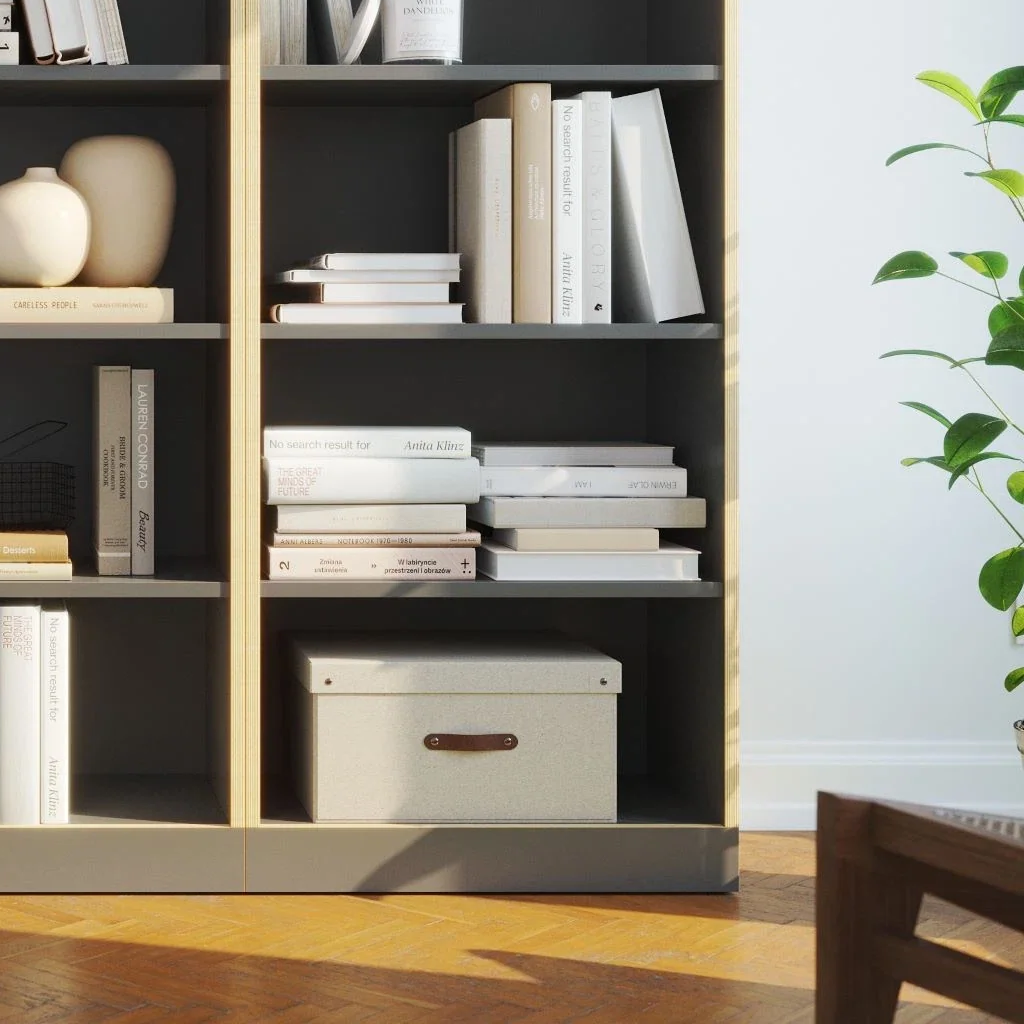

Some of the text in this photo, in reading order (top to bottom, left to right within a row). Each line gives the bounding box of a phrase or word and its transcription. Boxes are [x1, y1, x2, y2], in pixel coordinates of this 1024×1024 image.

[563, 105, 573, 216] No search result for
[562, 252, 573, 317] Anita Klinz
[13, 300, 78, 310] CARELESS PEOPLE
[118, 436, 126, 460] BRIDE
[269, 439, 371, 450] No search result for
[403, 440, 465, 451] Anita Klinz
[136, 383, 149, 552] LAUREN CONRAD Beauty
[278, 467, 323, 476] THE GREAT
[118, 470, 126, 500] GROOM
[278, 477, 317, 486] MINDS OF
[652, 481, 677, 490] ERWIN
[278, 487, 310, 496] FUTURE
[337, 537, 375, 545] NOTEBOOK
[3, 545, 36, 554] Desserts
[279, 561, 290, 570] 2
[405, 558, 437, 567] labiryncie
[384, 567, 421, 575] przestrzeni
[424, 566, 451, 574] obrazów
[3, 615, 12, 649] FUTURE
[14, 616, 22, 656] MINDS OF
[25, 616, 33, 661] THE GREAT
[49, 617, 59, 723] No search result for
[48, 756, 59, 818] Anita Klinz
